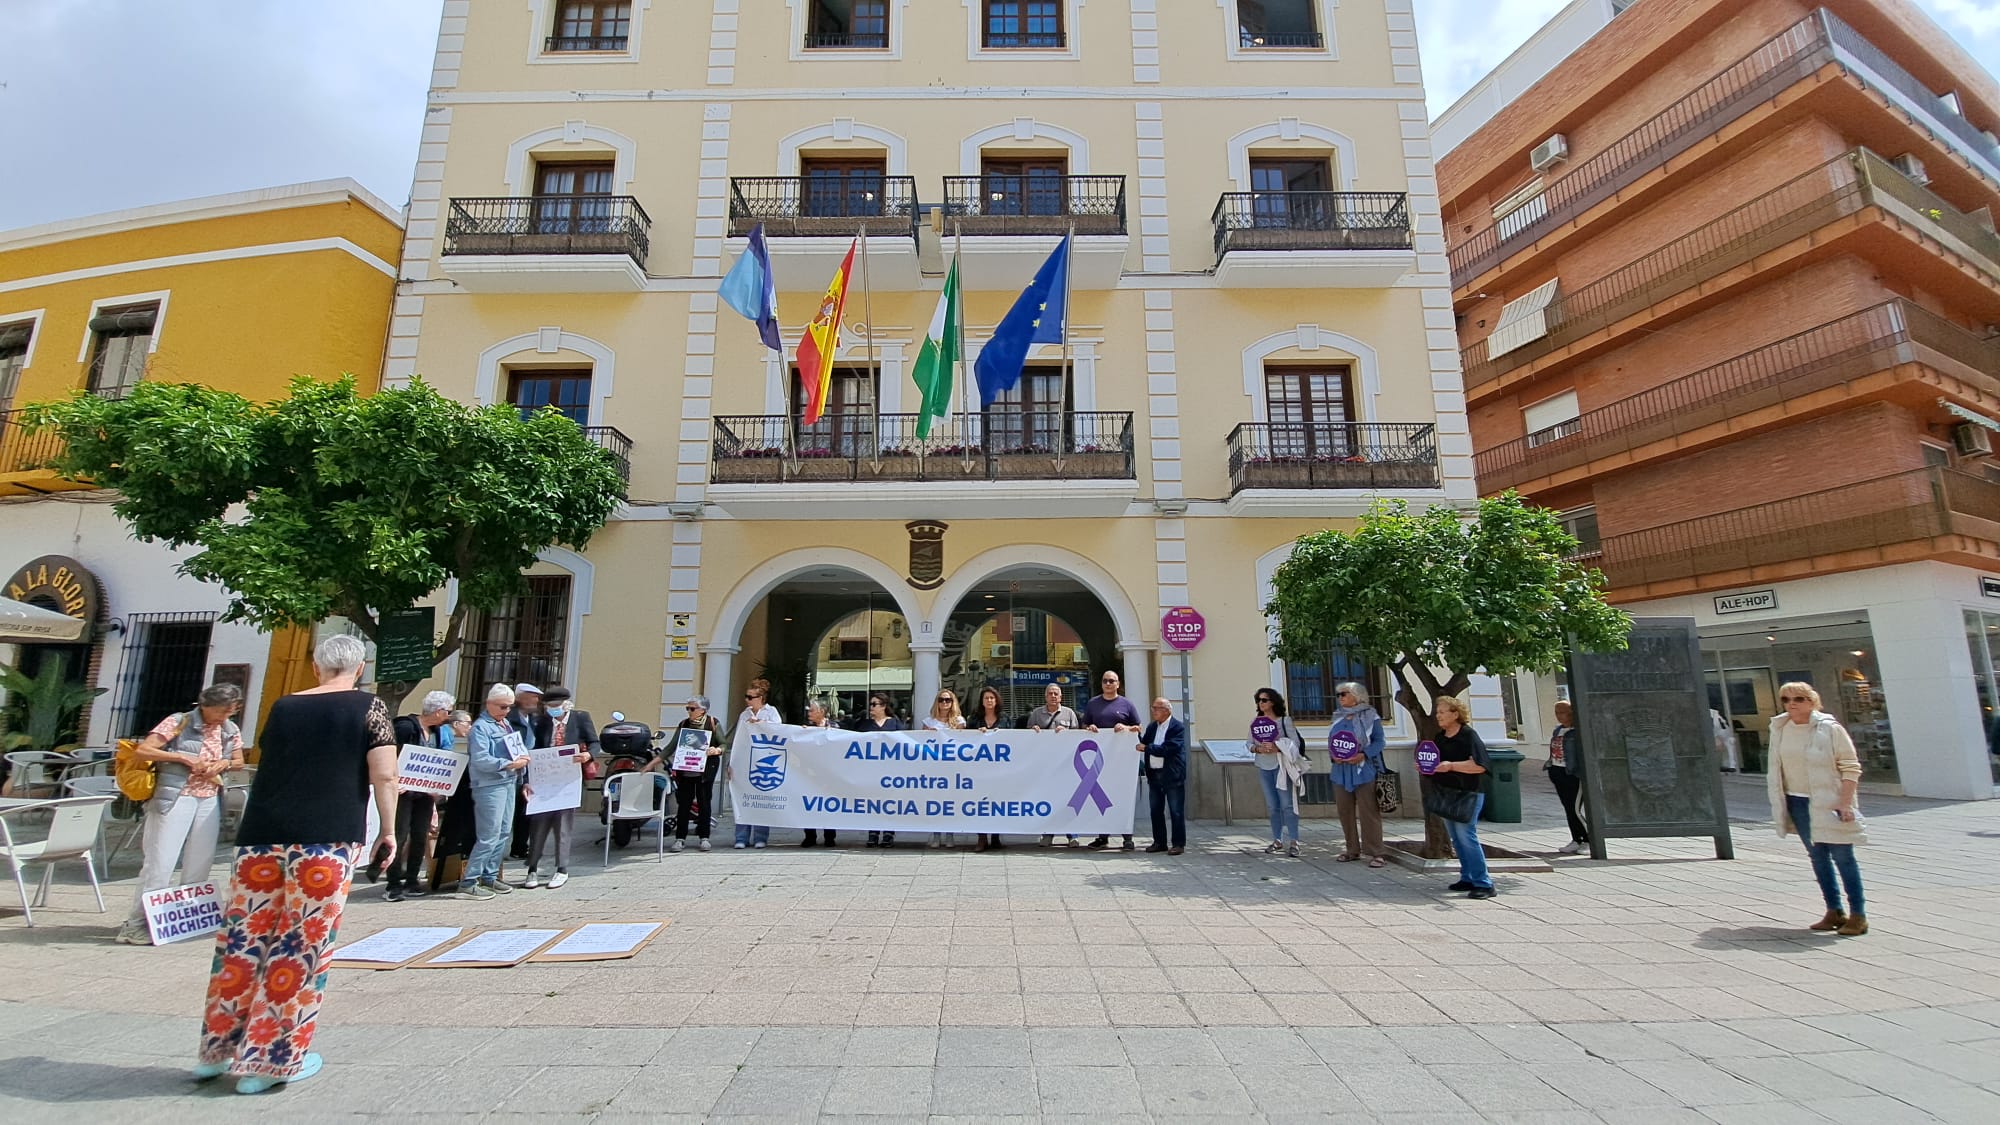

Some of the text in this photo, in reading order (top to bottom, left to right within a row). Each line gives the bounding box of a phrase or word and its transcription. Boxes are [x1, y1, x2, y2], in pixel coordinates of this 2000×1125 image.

[10, 582, 26, 600] A
[25, 564, 48, 591] LA
[1721, 596, 1769, 609] ALE-HOP
[1168, 624, 1201, 632] STOP
[1253, 725, 1275, 734] STOP
[844, 739, 1011, 762] ALMUÑÉCAR
[1332, 739, 1356, 750] STOP
[409, 752, 458, 767] VIOLENCIA
[1418, 751, 1438, 761] STOP
[404, 763, 452, 777] MACHISTA
[880, 773, 973, 789] contra la
[742, 792, 788, 802] Ayuntamiento
[751, 801, 787, 810] Almuñécar
[802, 795, 1052, 817] VIOLENCIA DE GÉNERO
[150, 884, 214, 907] HARTAS
[154, 901, 220, 925] VIOLENCIA
[157, 913, 222, 940] MACHISTA
